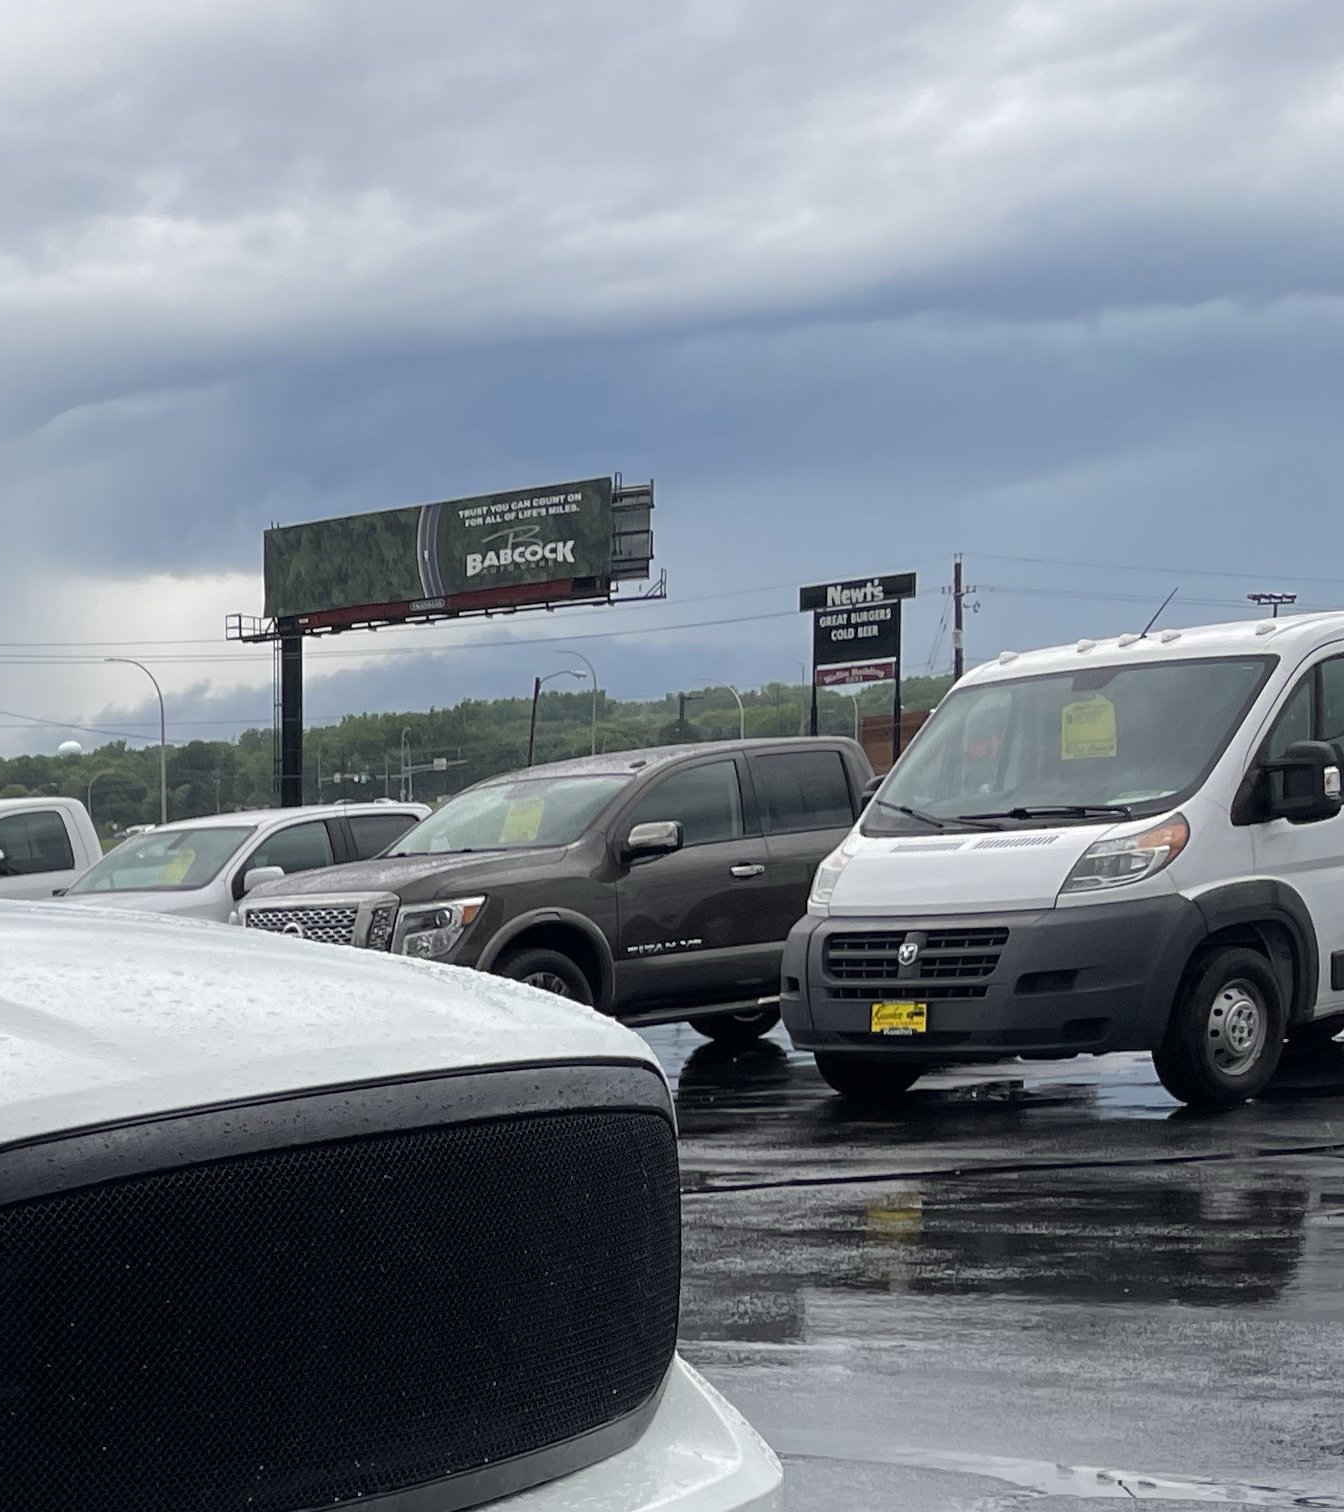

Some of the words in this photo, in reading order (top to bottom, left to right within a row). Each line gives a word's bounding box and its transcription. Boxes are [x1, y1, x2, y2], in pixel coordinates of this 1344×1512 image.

[458, 506, 489, 519] TRUST
[490, 503, 509, 513] YOU
[511, 500, 530, 510] CAN
[532, 495, 566, 506] COUNT
[567, 492, 582, 502] ON
[465, 518, 483, 527] FOR
[485, 514, 502, 525] ALL
[504, 511, 516, 521] OF
[518, 507, 547, 519] LIFE'S
[466, 540, 575, 577] BABCOCK
[826, 579, 884, 607] Newt's
[819, 613, 848, 628] GREAT
[850, 608, 892, 625] BURGERS
[830, 627, 855, 641] COLD
[857, 625, 879, 638] BEER
